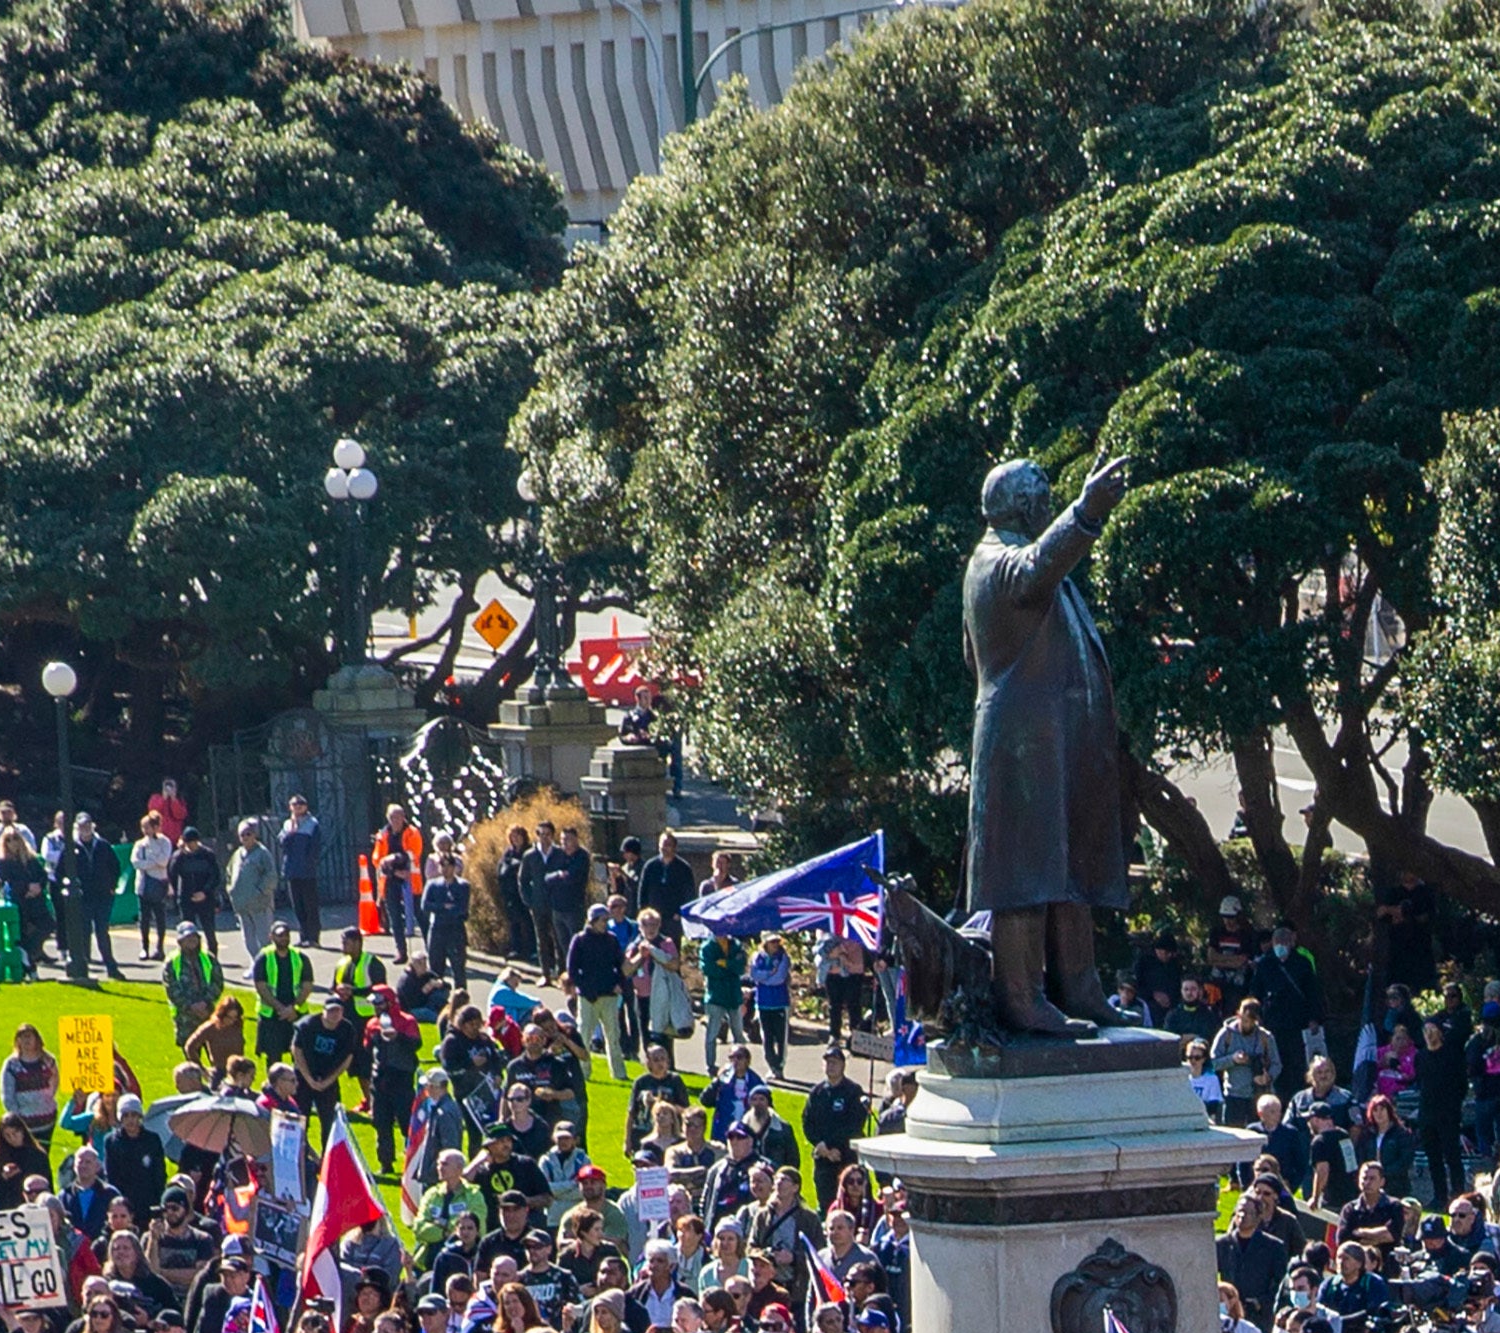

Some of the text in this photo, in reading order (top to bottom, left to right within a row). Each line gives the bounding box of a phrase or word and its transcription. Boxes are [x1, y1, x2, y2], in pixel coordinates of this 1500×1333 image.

[74, 1017, 97, 1030] THE
[65, 1031, 103, 1044] MEDIA
[76, 1047, 99, 1060] ARE
[78, 1062, 100, 1075] THE
[69, 1075, 106, 1089] VIRUS
[26, 1237, 49, 1257] MY
[31, 1268, 57, 1296] GO
